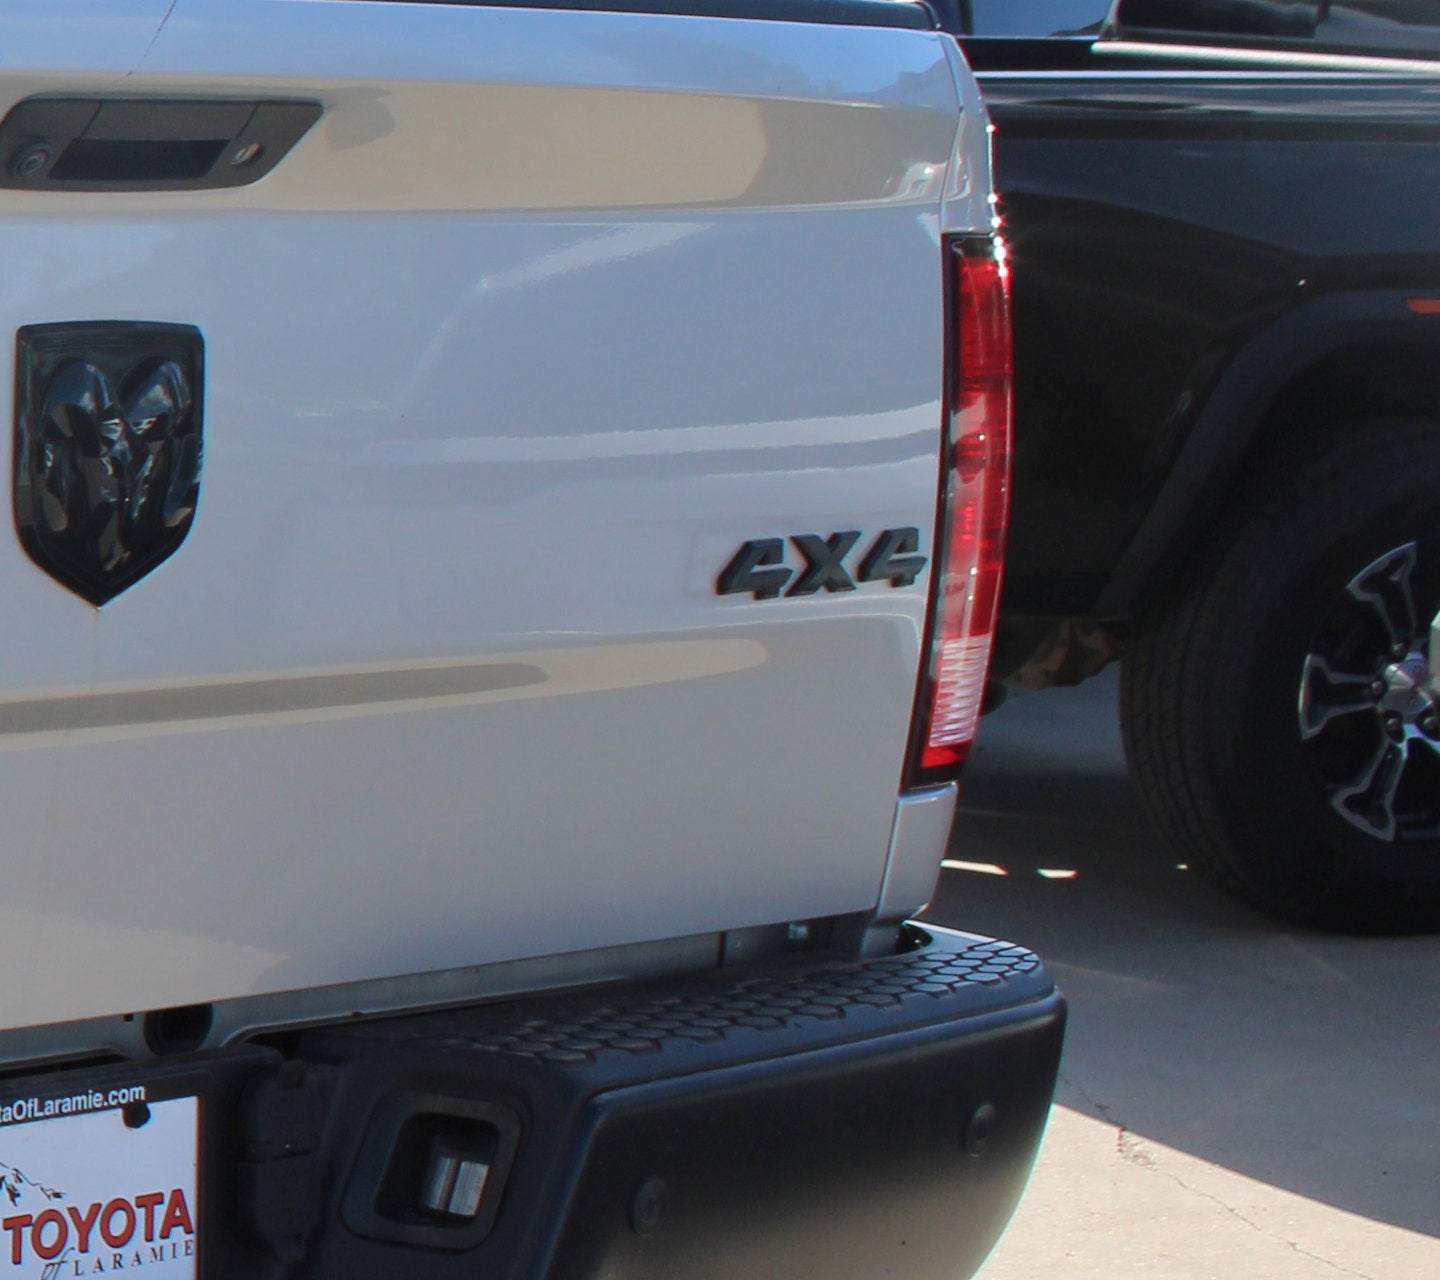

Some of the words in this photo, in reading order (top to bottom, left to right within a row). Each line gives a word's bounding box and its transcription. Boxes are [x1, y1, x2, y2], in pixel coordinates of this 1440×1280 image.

[714, 527, 928, 600] 4X4
[2, 1188, 194, 1265] TOYOTA
[73, 1239, 194, 1276] LARAMIE
